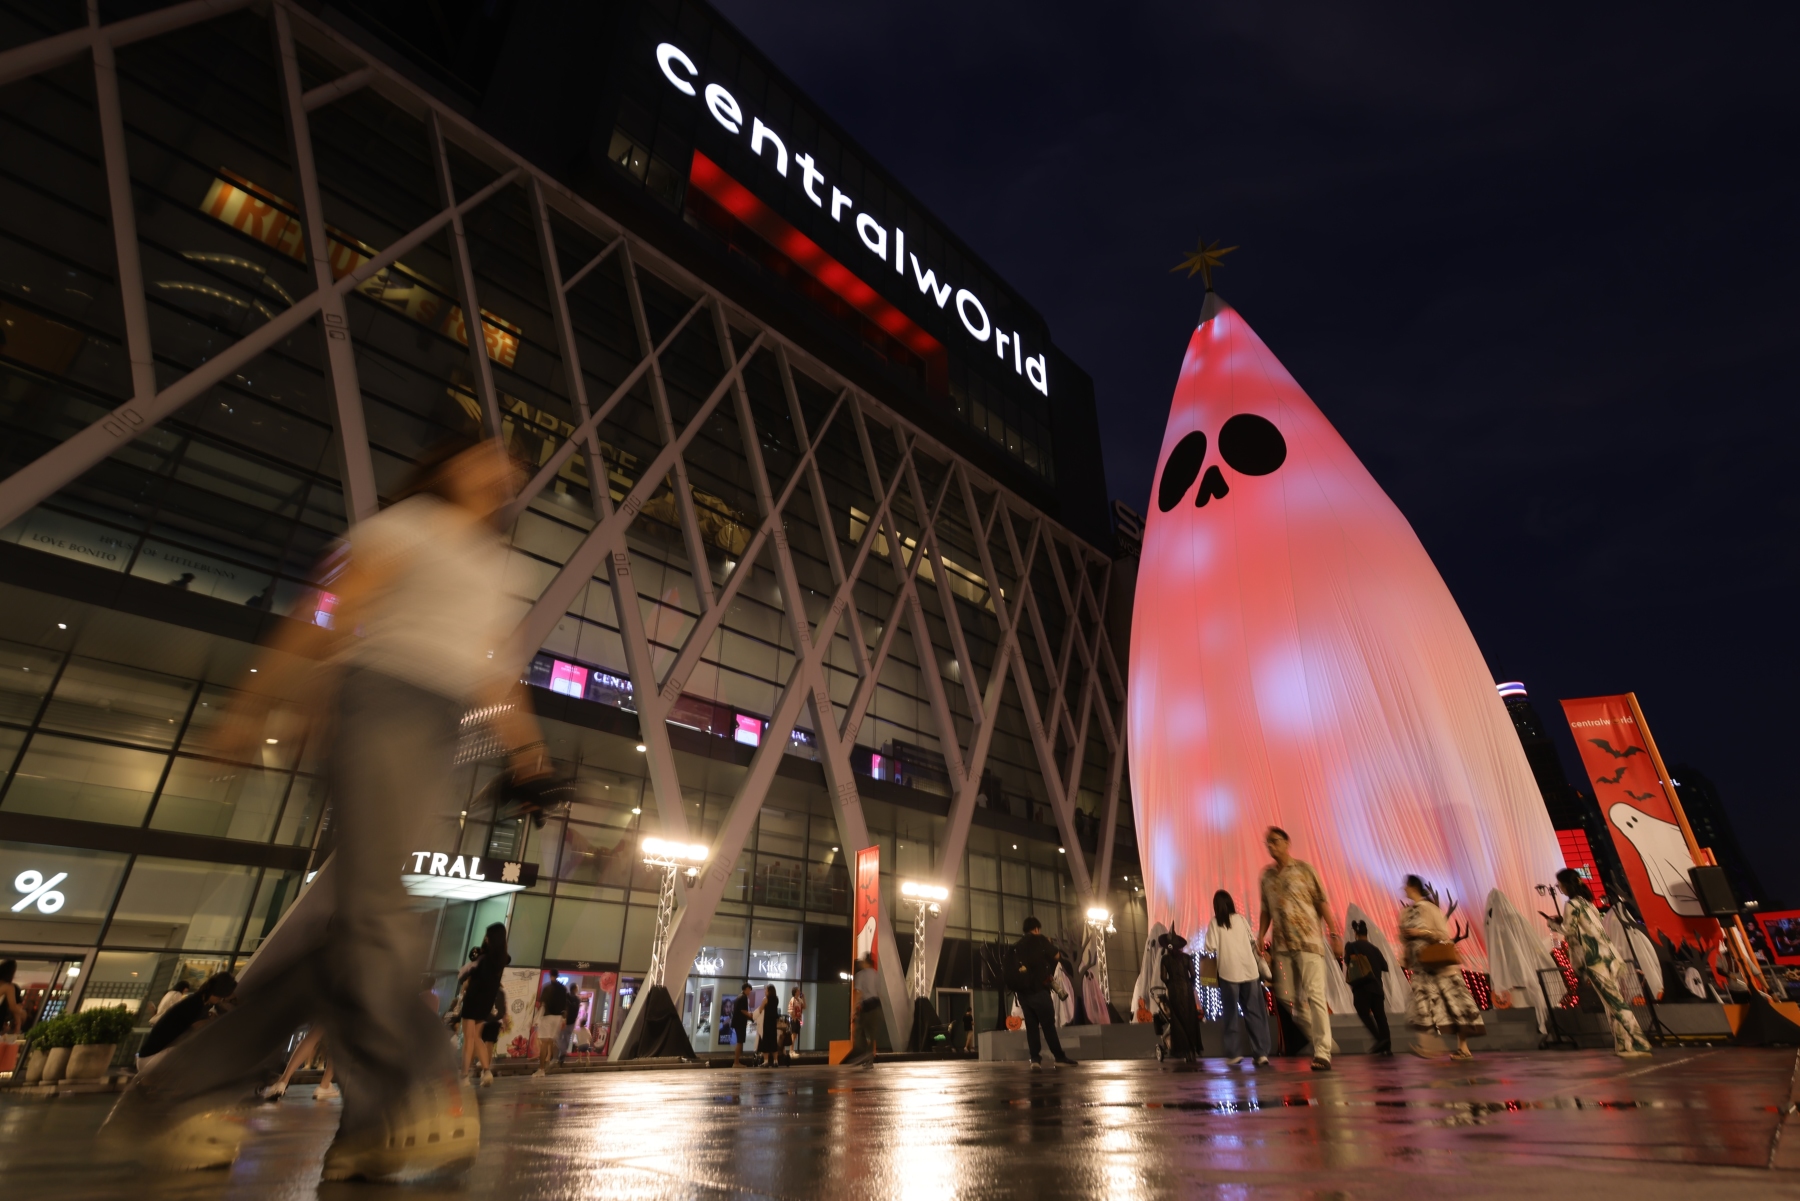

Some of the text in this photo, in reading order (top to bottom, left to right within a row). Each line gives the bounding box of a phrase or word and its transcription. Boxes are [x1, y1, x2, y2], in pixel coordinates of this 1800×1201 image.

[209, 166, 360, 282] TRED
[33, 533, 117, 563] LOVE BONITO
[402, 852, 485, 881] TRAL
[759, 959, 788, 974] KIKO
